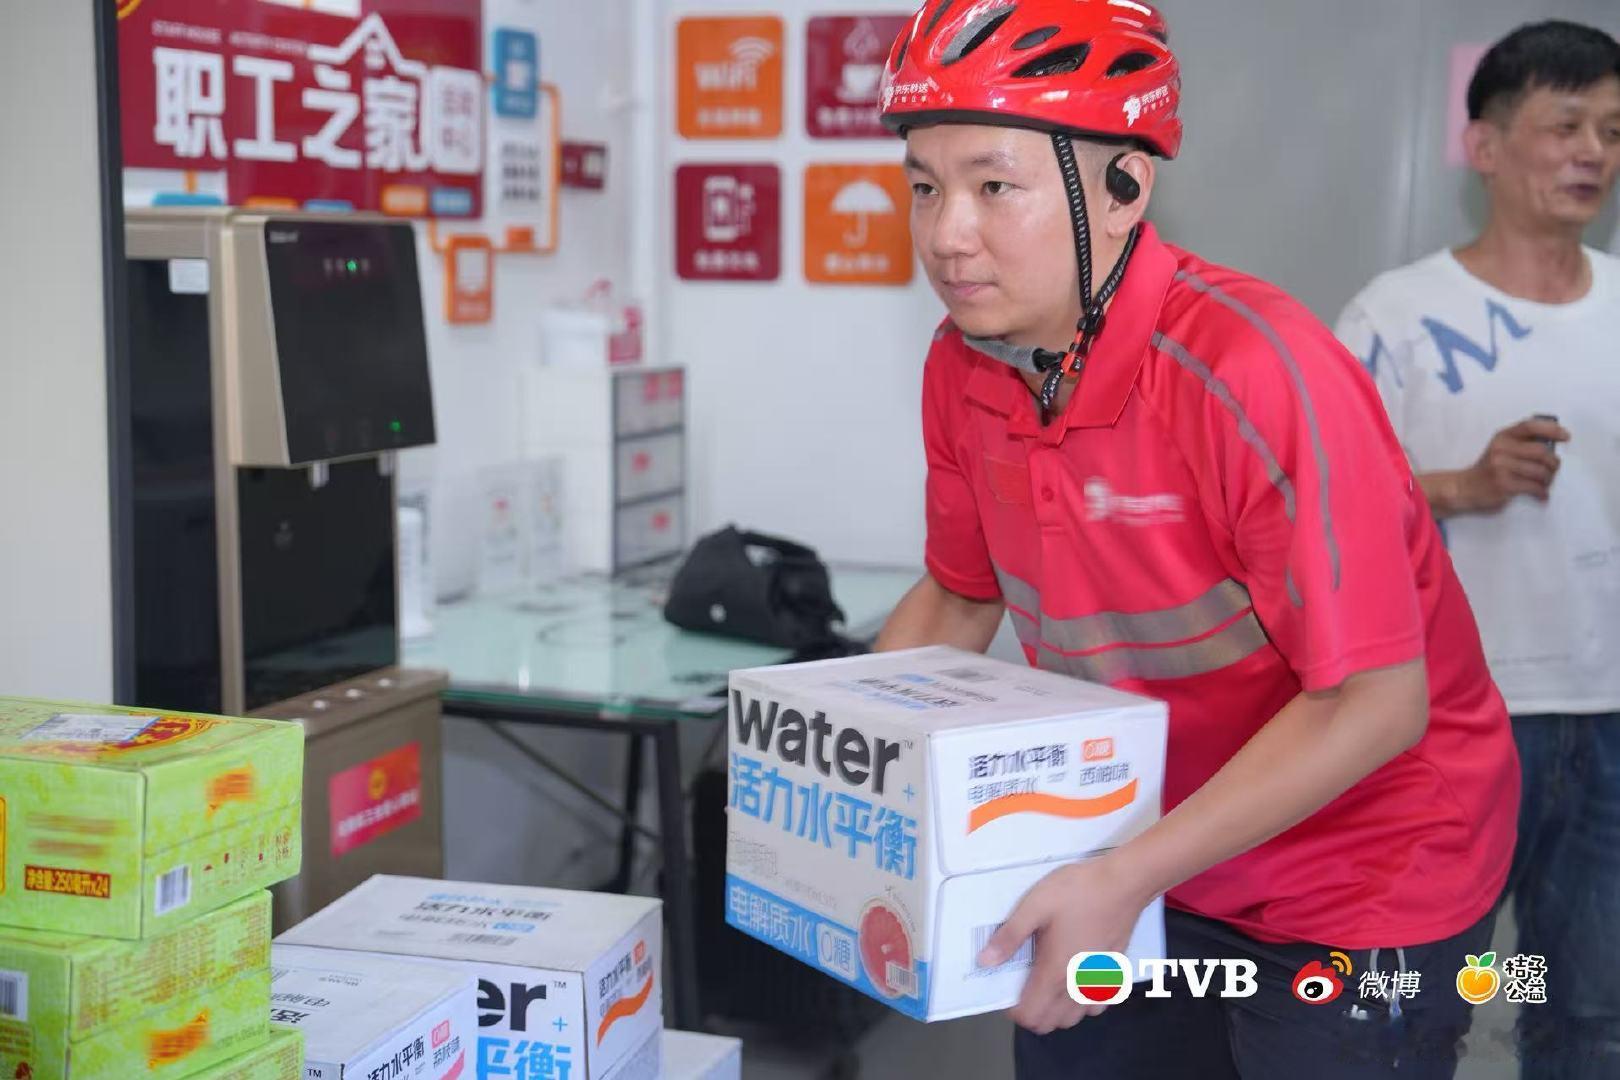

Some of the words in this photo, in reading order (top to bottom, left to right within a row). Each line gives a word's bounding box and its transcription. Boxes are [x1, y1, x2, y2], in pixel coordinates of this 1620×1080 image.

[153, 12, 429, 172] 职工之家
[732, 688, 901, 797] water
[968, 743, 1068, 780] 活力水平衡
[730, 751, 918, 881] 活力水平衡
[730, 886, 811, 957] 电解质水
[819, 929, 852, 972] 0糖
